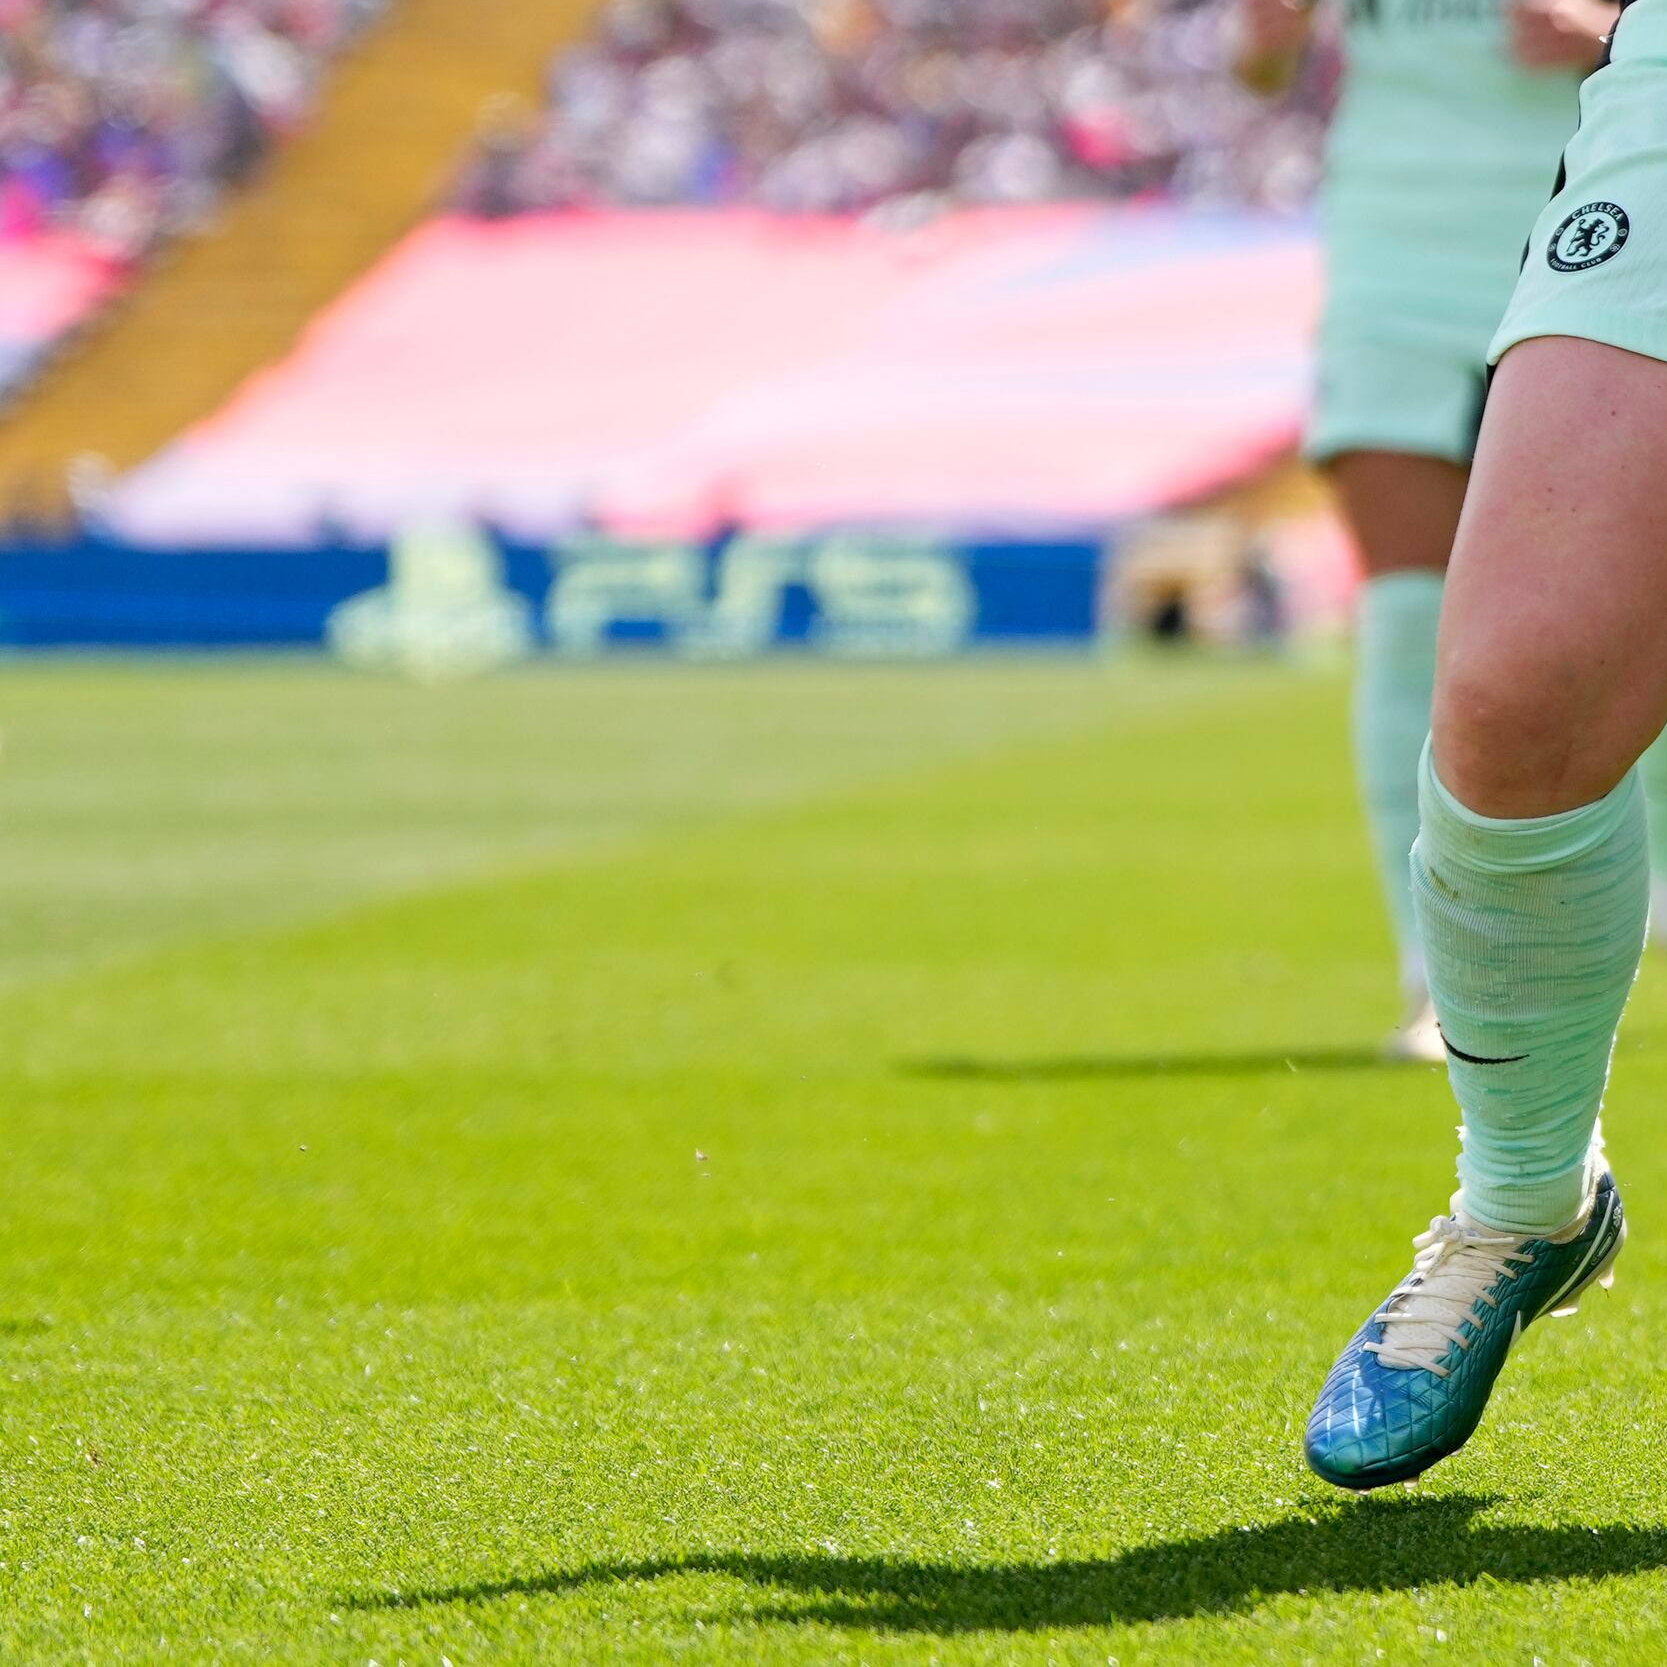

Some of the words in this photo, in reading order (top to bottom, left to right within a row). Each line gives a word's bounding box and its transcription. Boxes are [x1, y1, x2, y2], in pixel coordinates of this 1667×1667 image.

[1571, 203, 1624, 221] CHELSEA
[1550, 257, 1578, 271] FOOTBALL
[1580, 256, 1602, 269] CLUB
